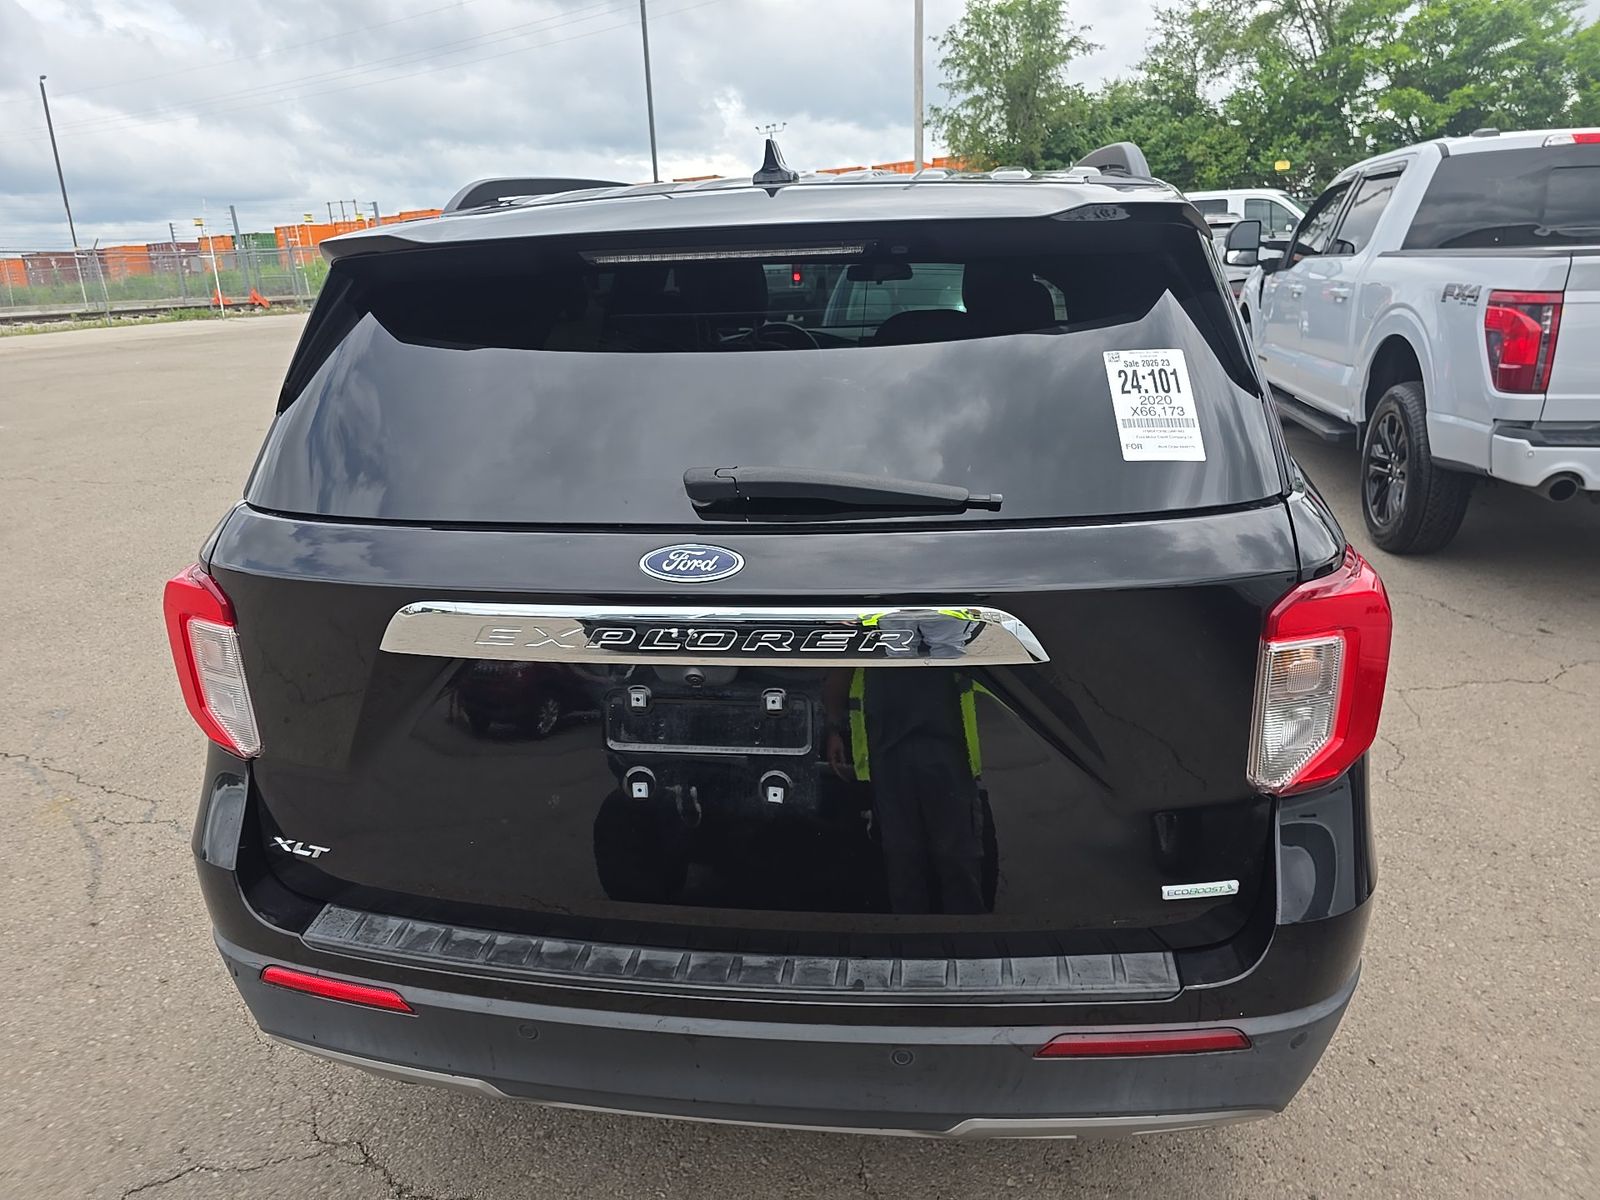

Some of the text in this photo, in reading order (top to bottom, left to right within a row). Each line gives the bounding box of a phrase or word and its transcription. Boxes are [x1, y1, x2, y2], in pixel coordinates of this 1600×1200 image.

[1441, 283, 1481, 302] FX4
[1123, 360, 1140, 368] Sale
[1161, 359, 1171, 367] 23
[1118, 368, 1181, 394] 24:101
[1139, 395, 1172, 405] 2020
[1131, 406, 1186, 418] X66,173
[662, 549, 720, 572] Ford
[474, 624, 914, 652] EXPLORER
[270, 836, 331, 858] XLT
[1167, 885, 1225, 897] ECOBOOST
